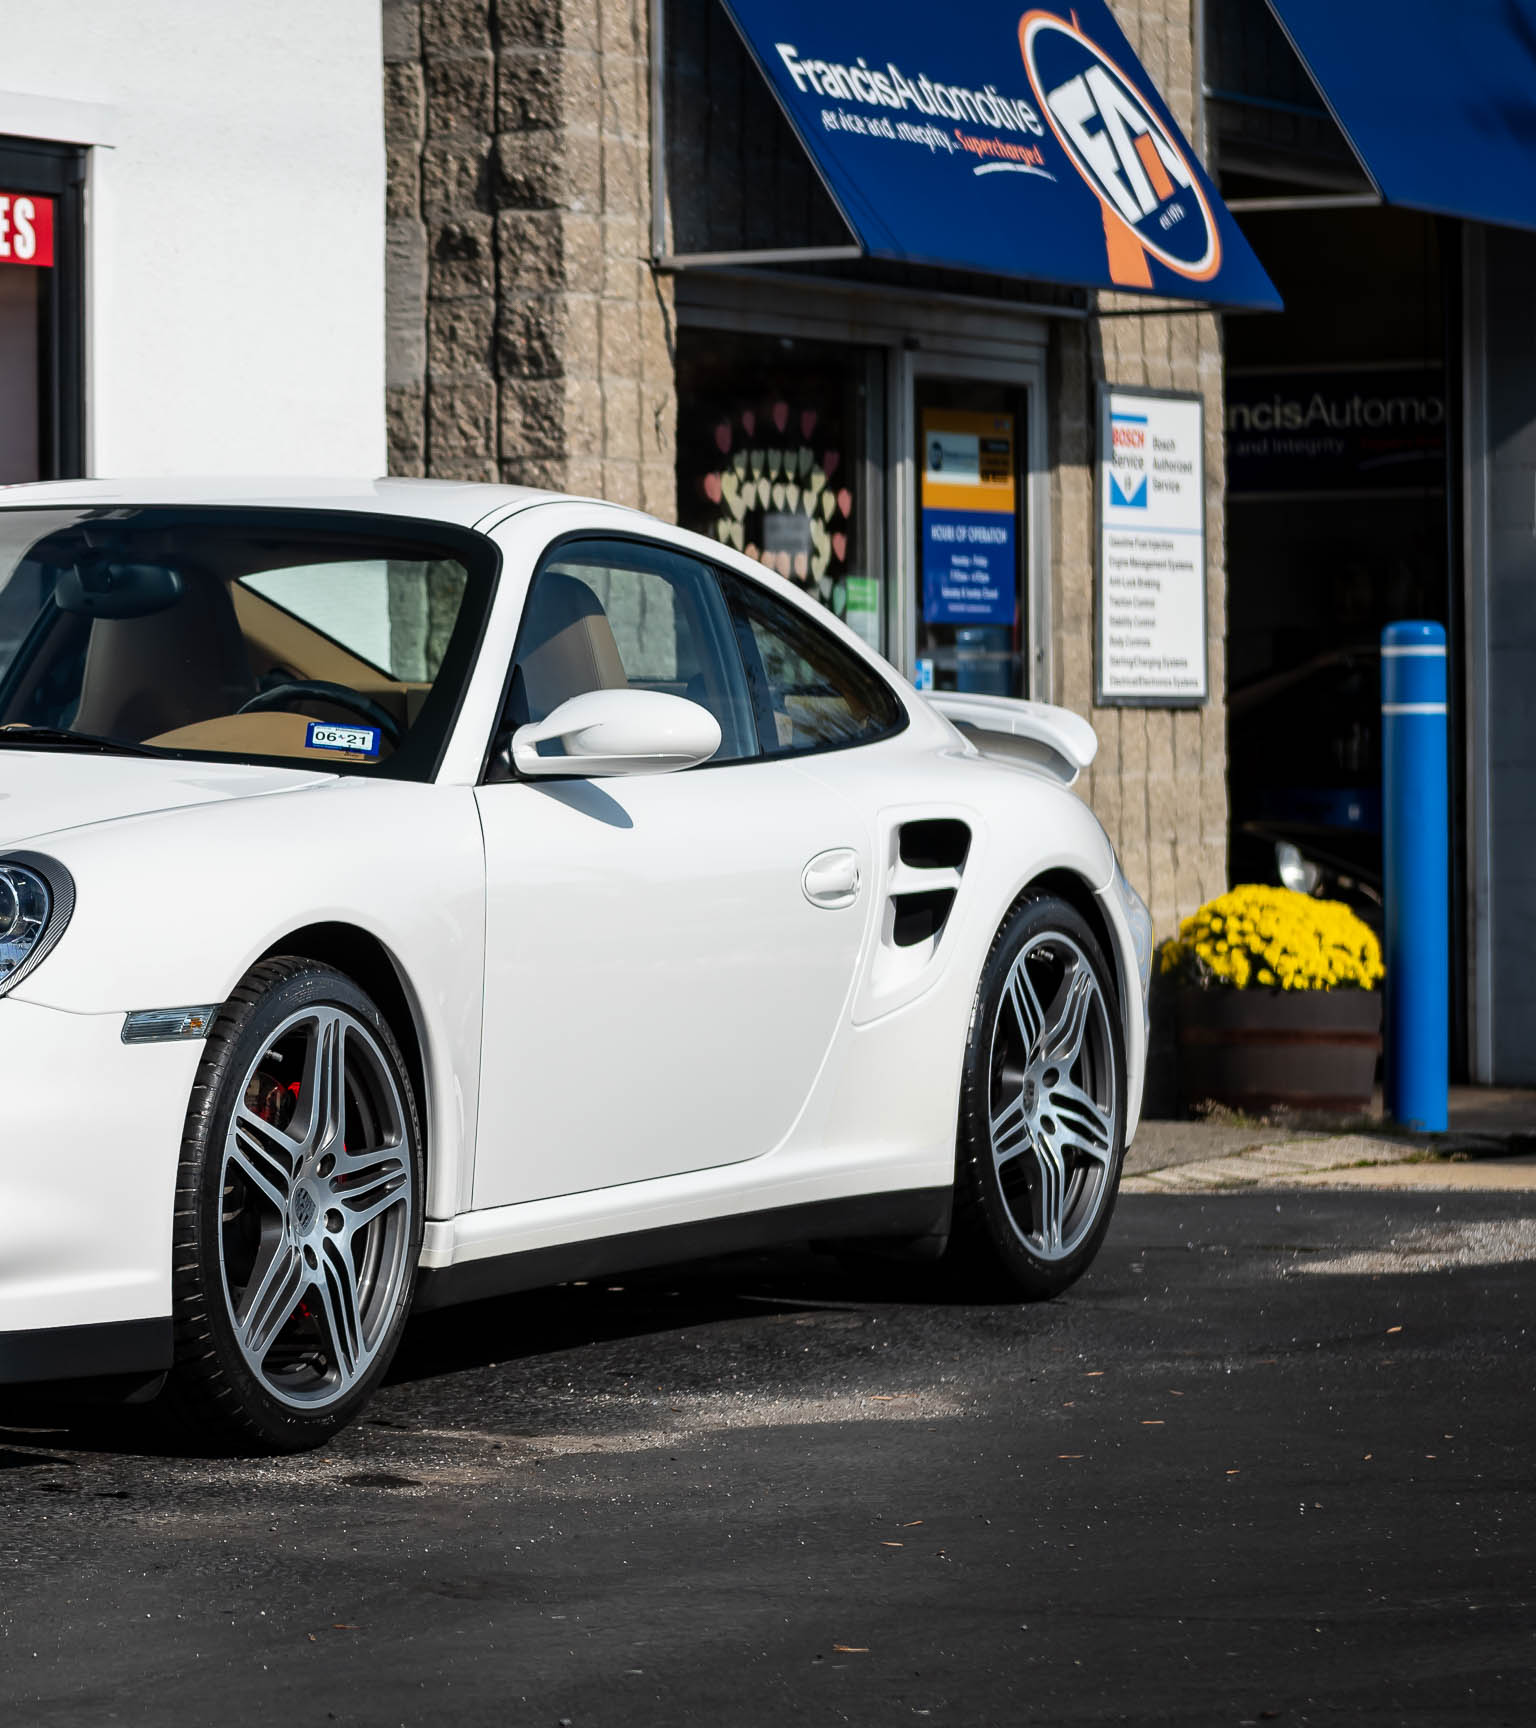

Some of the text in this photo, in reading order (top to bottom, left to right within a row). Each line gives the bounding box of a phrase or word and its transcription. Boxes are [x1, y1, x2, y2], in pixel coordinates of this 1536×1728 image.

[775, 43, 1045, 137] FrancisAutomotive
[954, 128, 1045, 167] Supercharged
[1225, 392, 1443, 431] ncisAutomo
[1110, 427, 1145, 448] BOSCH
[1110, 448, 1144, 471] Service
[1152, 478, 1181, 494] Service
